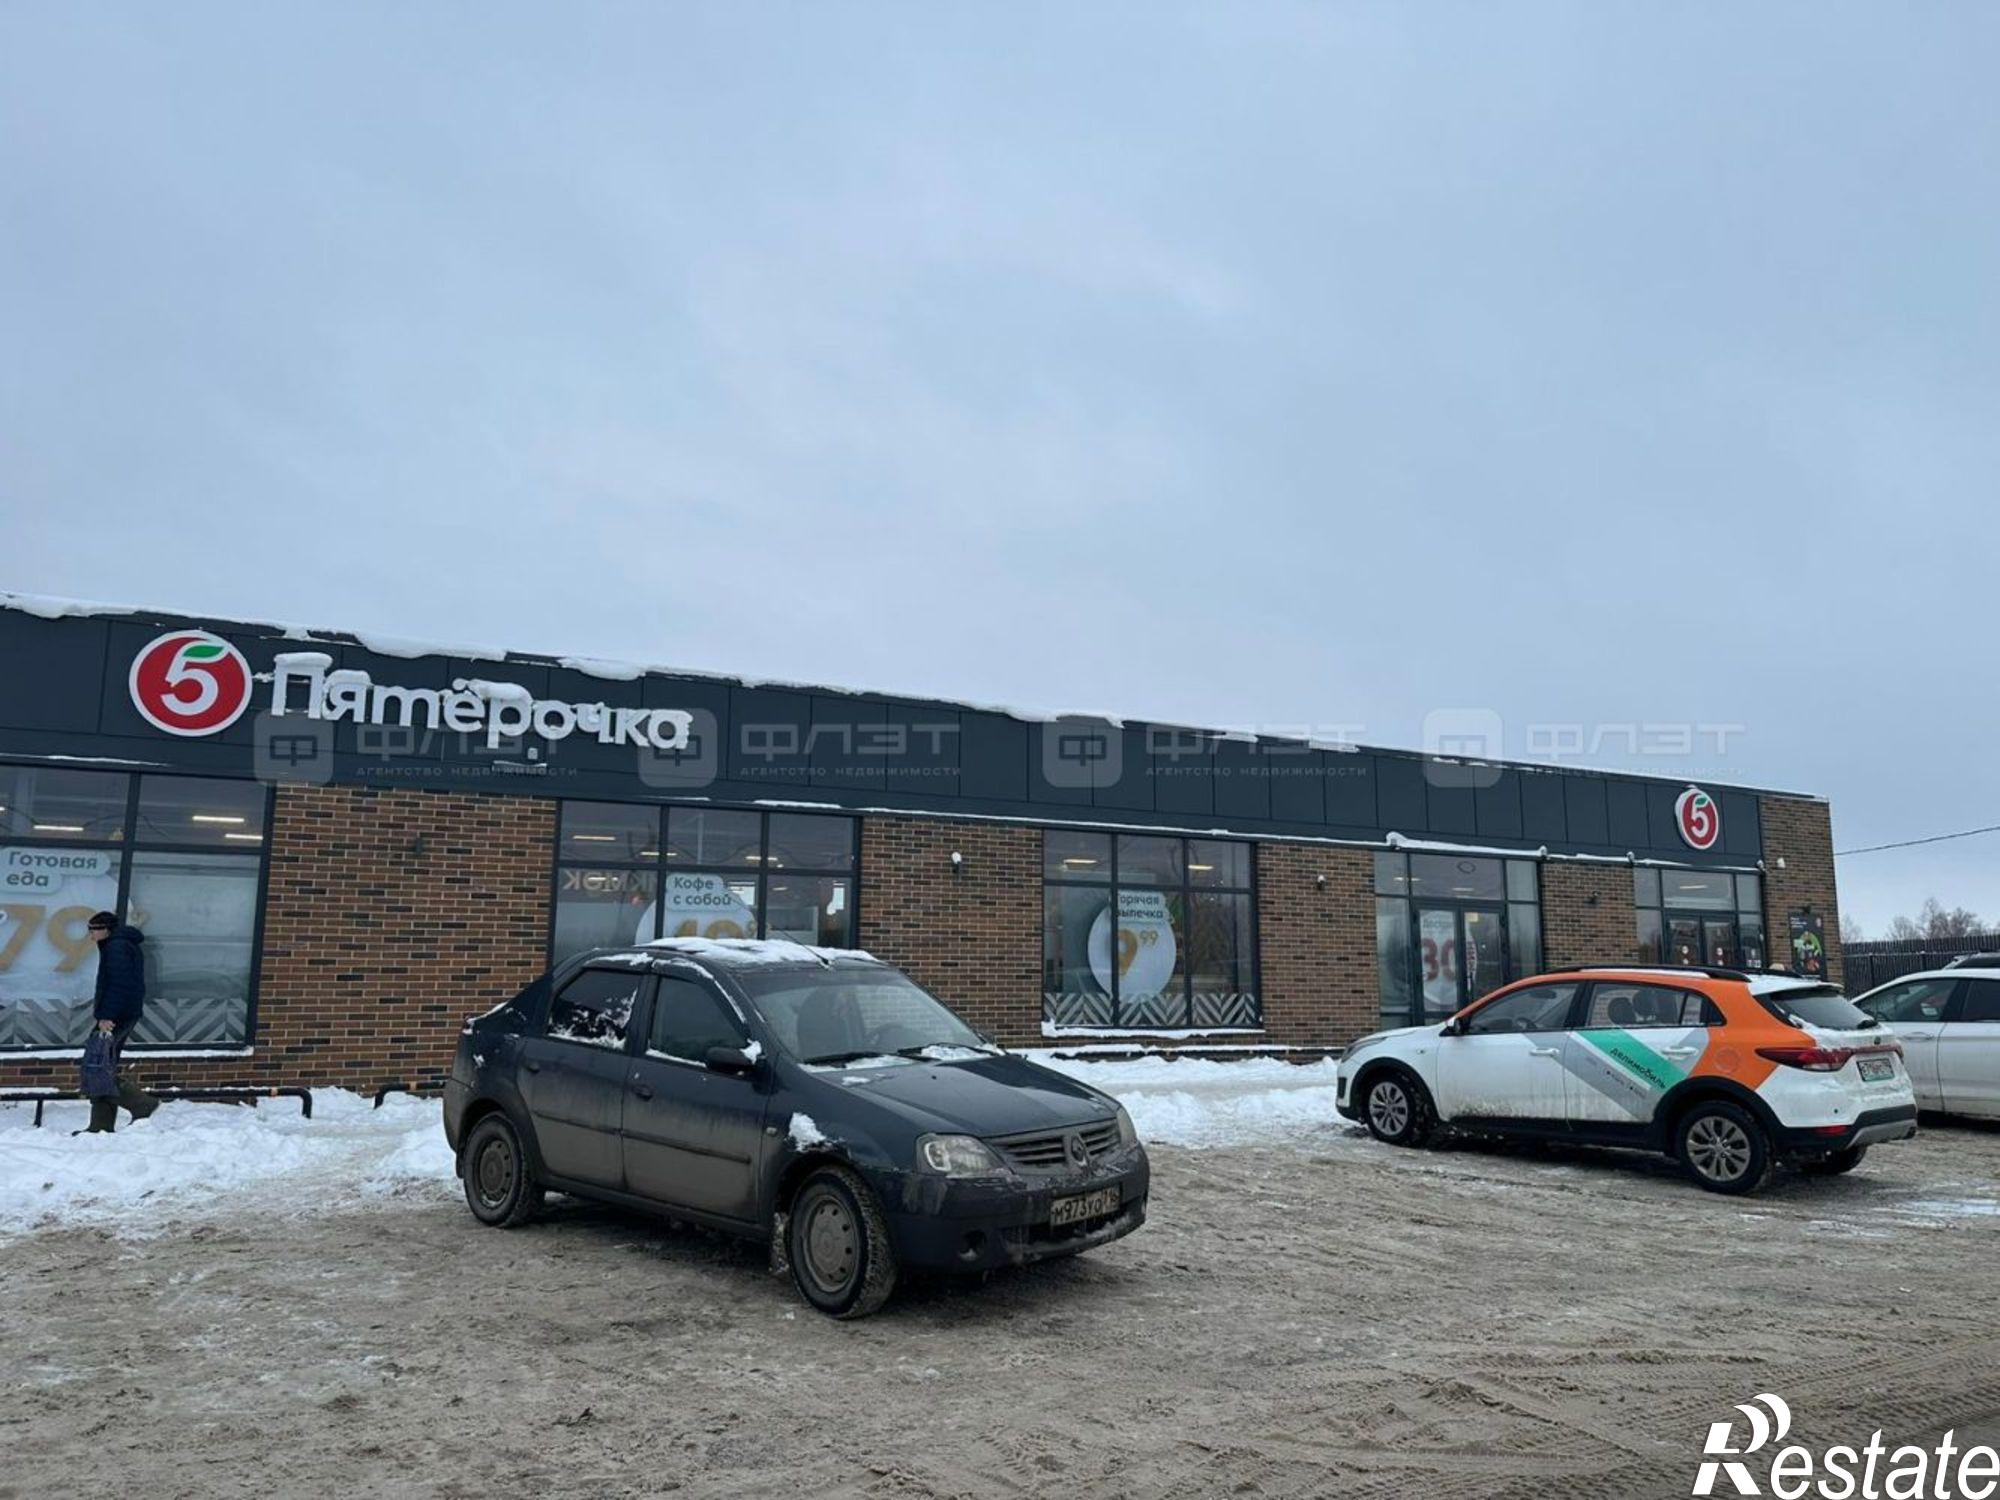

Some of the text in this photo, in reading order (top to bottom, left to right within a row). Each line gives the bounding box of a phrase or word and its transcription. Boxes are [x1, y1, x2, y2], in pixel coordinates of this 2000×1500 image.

[160, 643, 225, 717] 5
[271, 654, 694, 750] Пятёрочка
[1691, 794, 1711, 838] 5
[8, 851, 98, 870] Готовая
[6, 871, 50, 887] еда
[674, 876, 715, 892] Кофе
[673, 893, 732, 907] с собой
[1118, 895, 1160, 907] орячая
